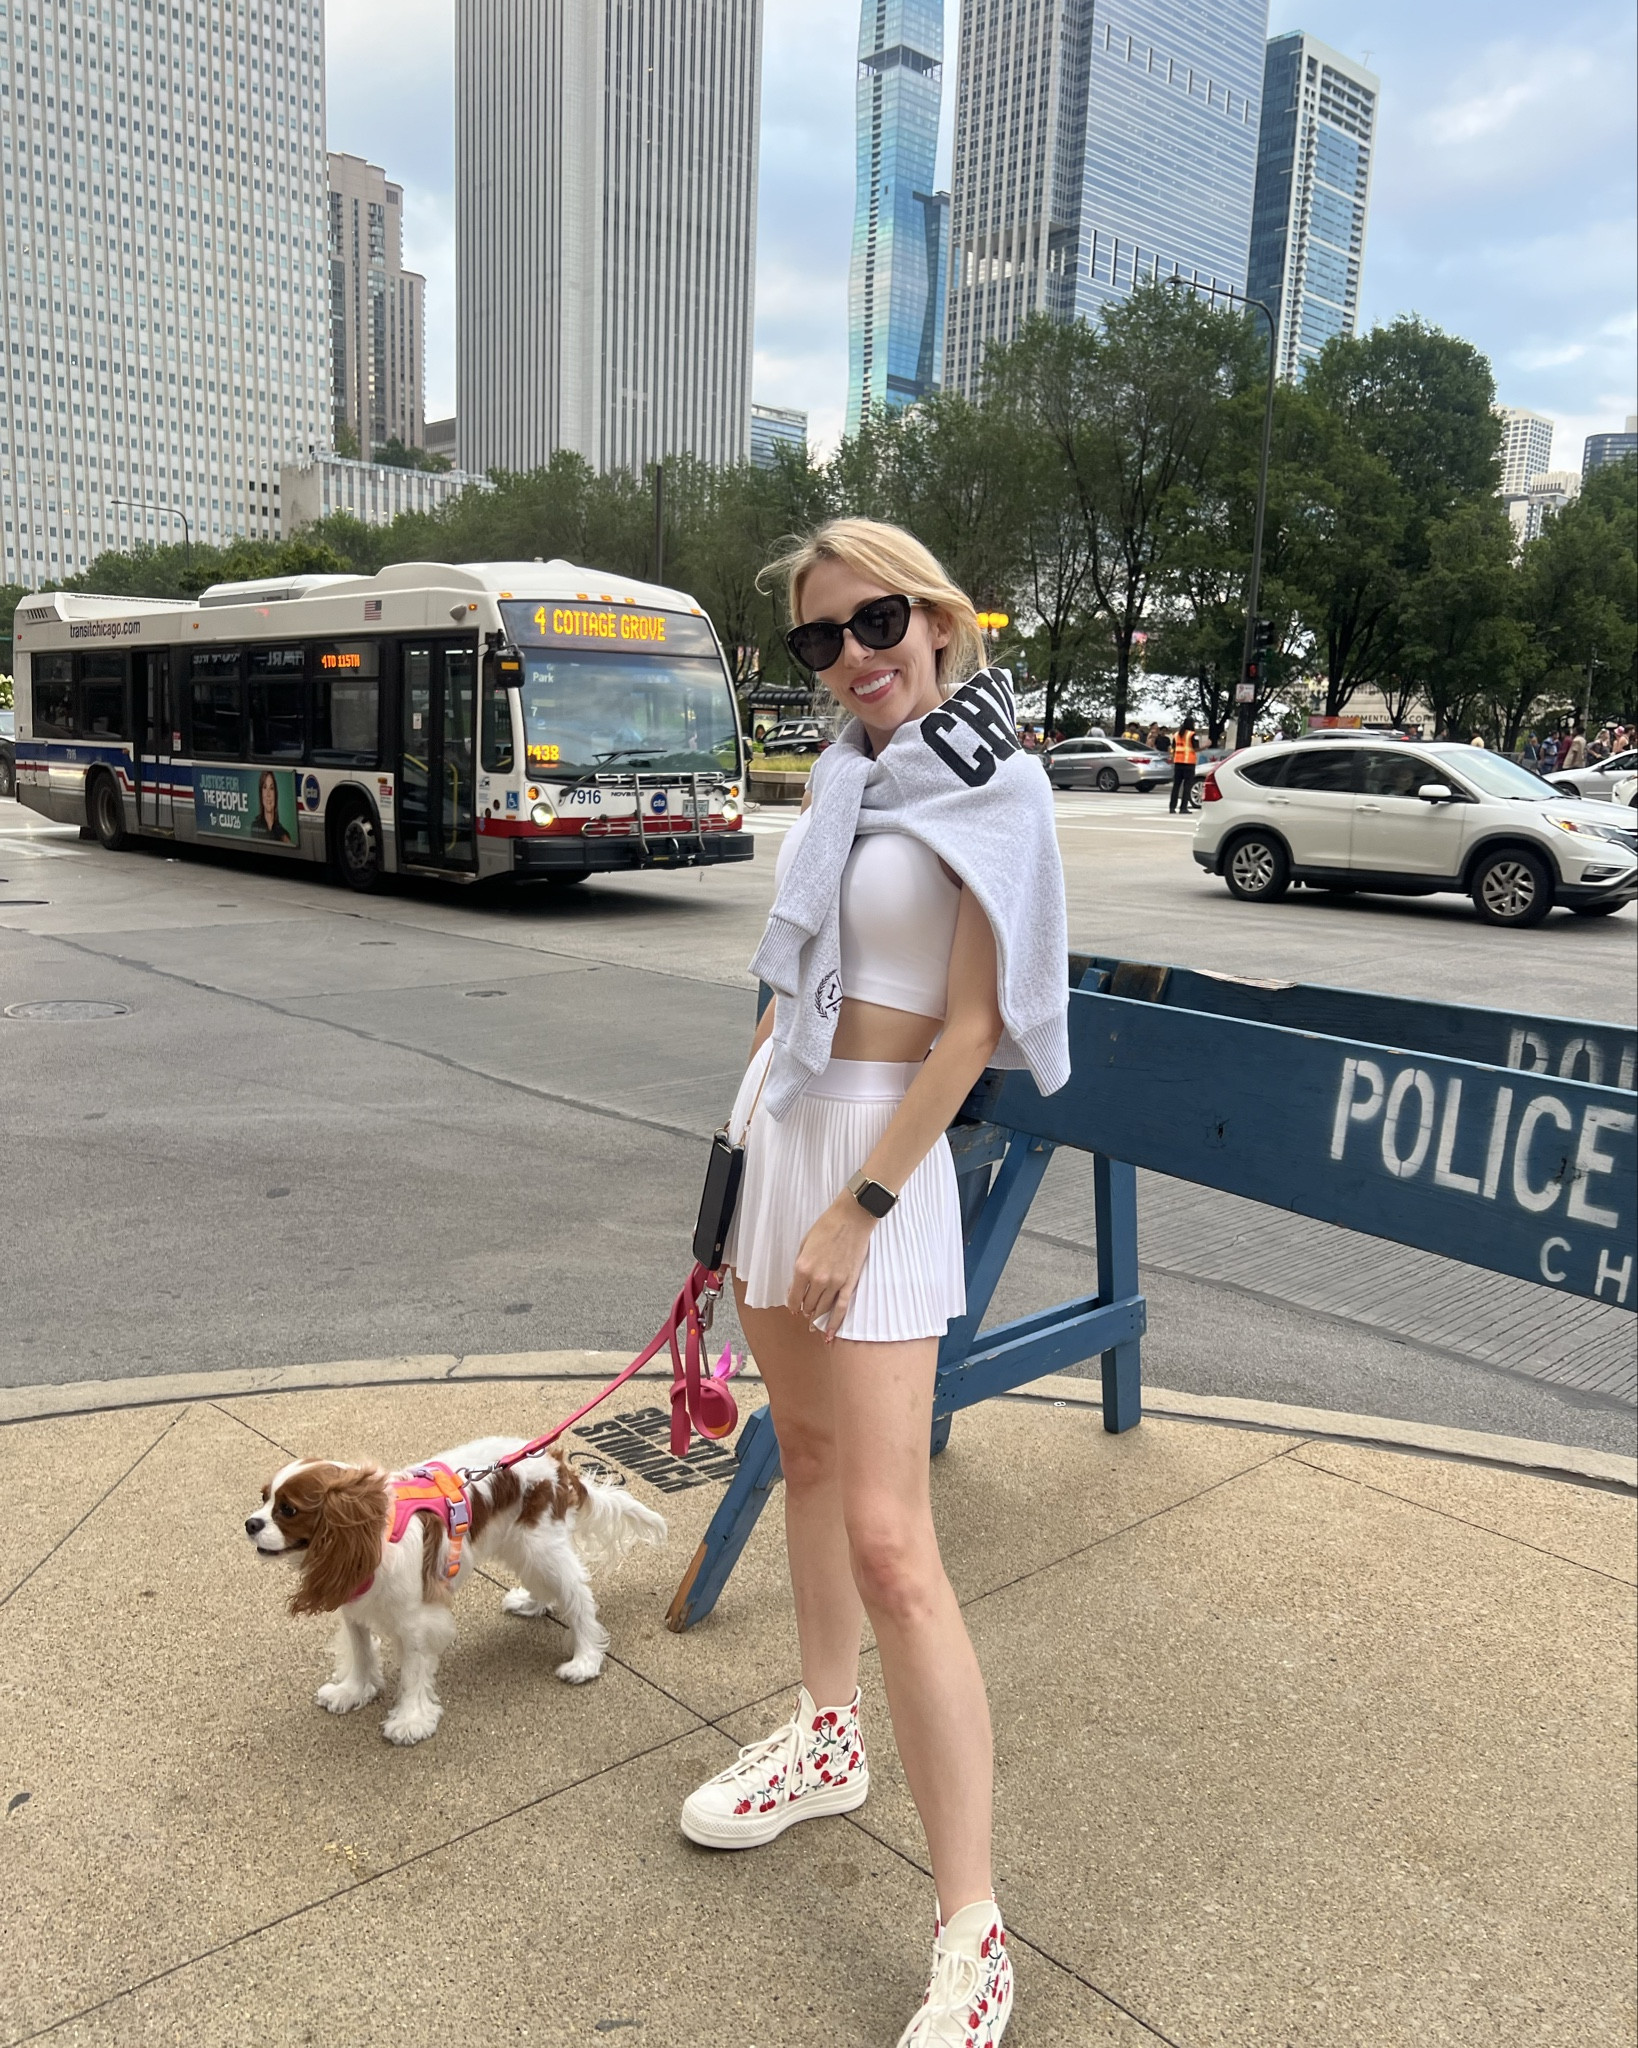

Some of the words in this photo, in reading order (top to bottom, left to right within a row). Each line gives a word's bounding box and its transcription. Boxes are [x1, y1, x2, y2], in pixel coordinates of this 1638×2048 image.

[70, 620, 141, 639] transitchicago.com
[534, 606, 547, 635] 4
[553, 608, 617, 638] COTTAGE
[620, 613, 666, 641] GROVE
[337, 653, 360, 668] 115TH
[532, 671, 554, 683] Park
[200, 774, 226, 789] JUSTICE
[226, 776, 239, 791] FOR
[203, 789, 216, 804] THE
[215, 791, 249, 812] PEOPLE
[569, 789, 602, 804] 7916
[652, 798, 666, 808] cta
[1330, 1057, 1637, 1229] POLICE
[571, 1420, 711, 1494] STOMACH
